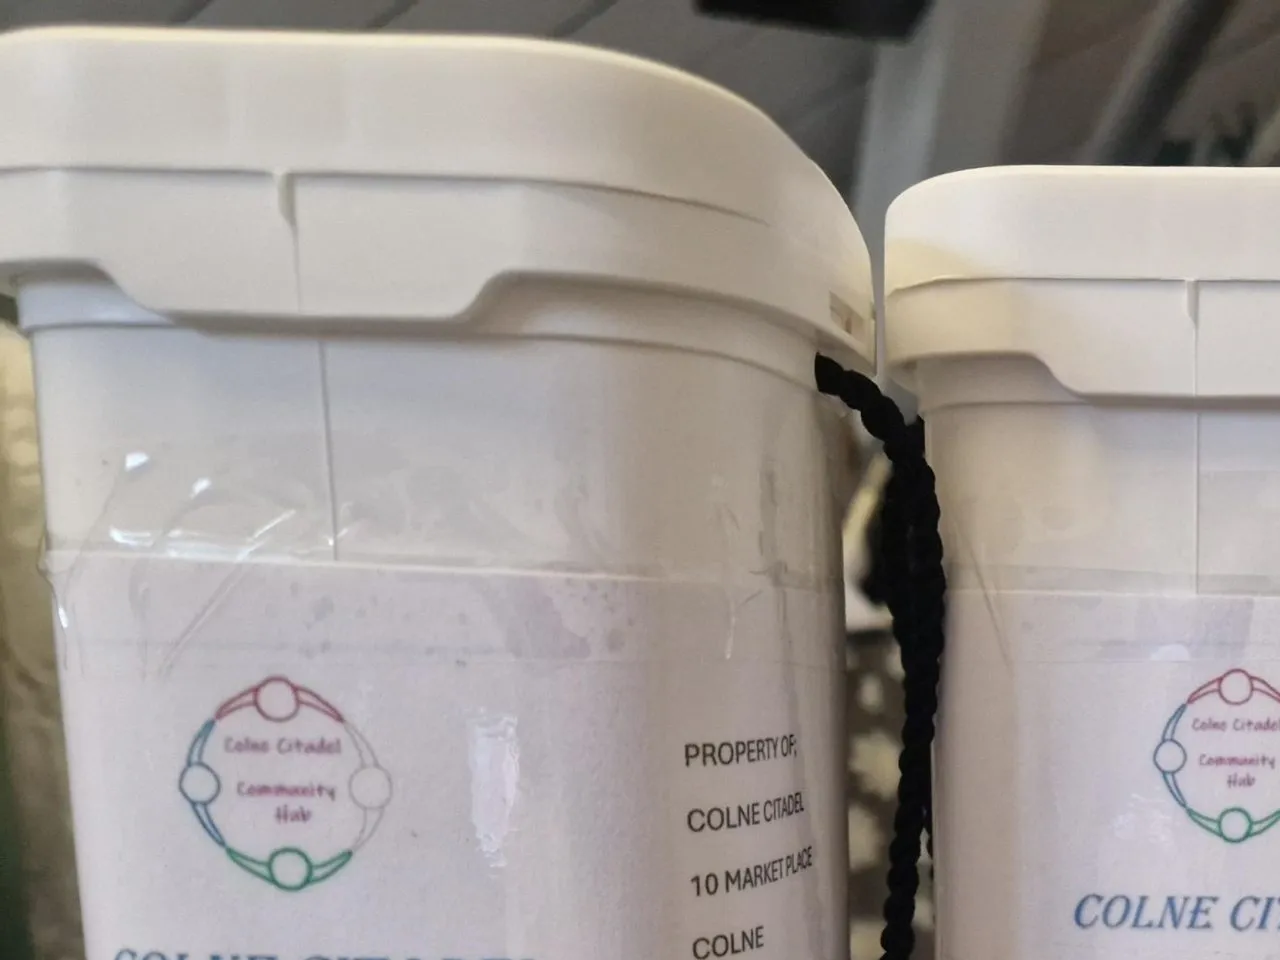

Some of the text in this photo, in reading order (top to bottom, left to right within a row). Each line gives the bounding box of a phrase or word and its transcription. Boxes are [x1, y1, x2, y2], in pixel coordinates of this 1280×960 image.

[1192, 717, 1228, 732] Colne
[224, 737, 342, 756] Colne Citadel
[684, 735, 779, 767] PROPERTY
[1199, 753, 1276, 770] Community
[236, 781, 337, 801] Community
[274, 804, 313, 824] Hub
[687, 791, 804, 832] COLNE CITADEL
[691, 846, 813, 897] 10 MARKET PLACE
[1073, 893, 1220, 930] COLNE
[692, 925, 765, 960] COLNE
